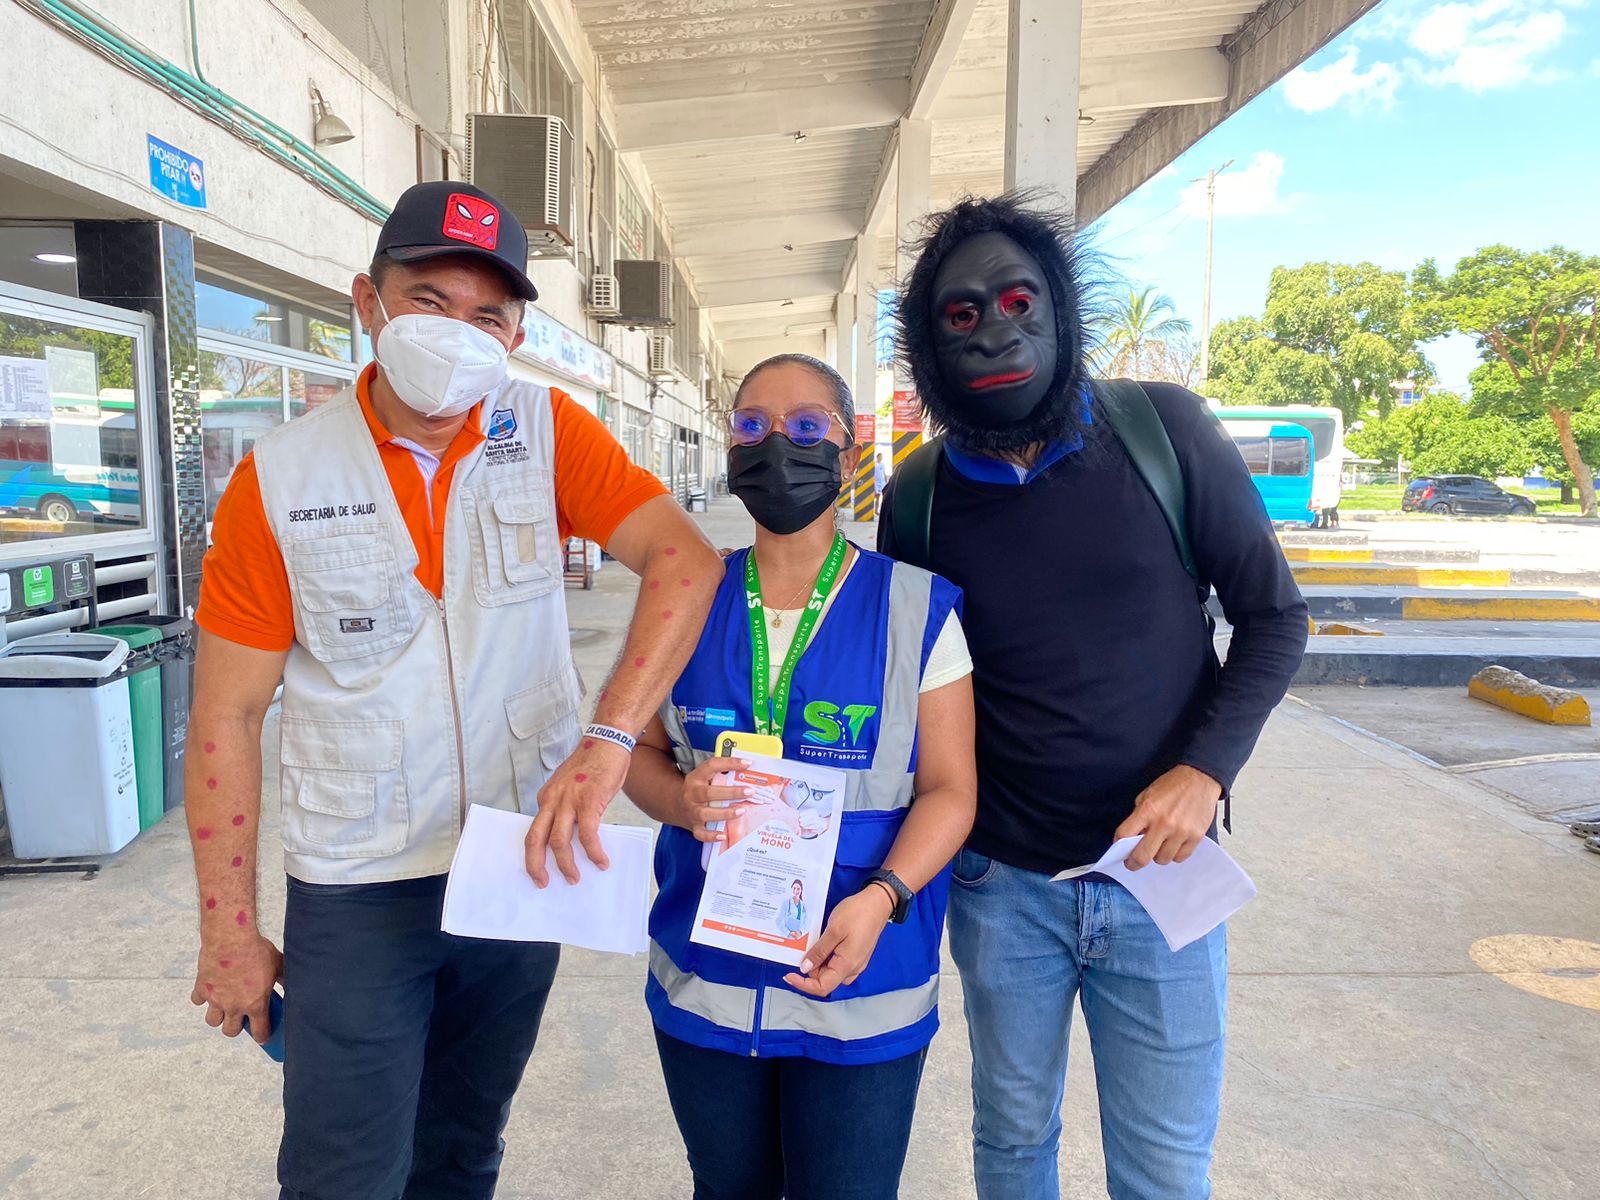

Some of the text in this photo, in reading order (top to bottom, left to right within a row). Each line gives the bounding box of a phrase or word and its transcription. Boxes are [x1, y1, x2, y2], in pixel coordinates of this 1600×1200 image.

[149, 142, 189, 173] PROHIBIDO
[161, 162, 181, 183] PITAR
[289, 502, 376, 522] SECRETARIA DE SALUD
[746, 590, 762, 609] ST
[808, 588, 825, 611] ST
[754, 619, 764, 705] SuperTransporte
[776, 621, 810, 709] SuperTransporte
[802, 700, 877, 747] ST
[757, 829, 782, 840] VIRUELA
[783, 835, 795, 843] DEL
[760, 837, 792, 849] MONO
